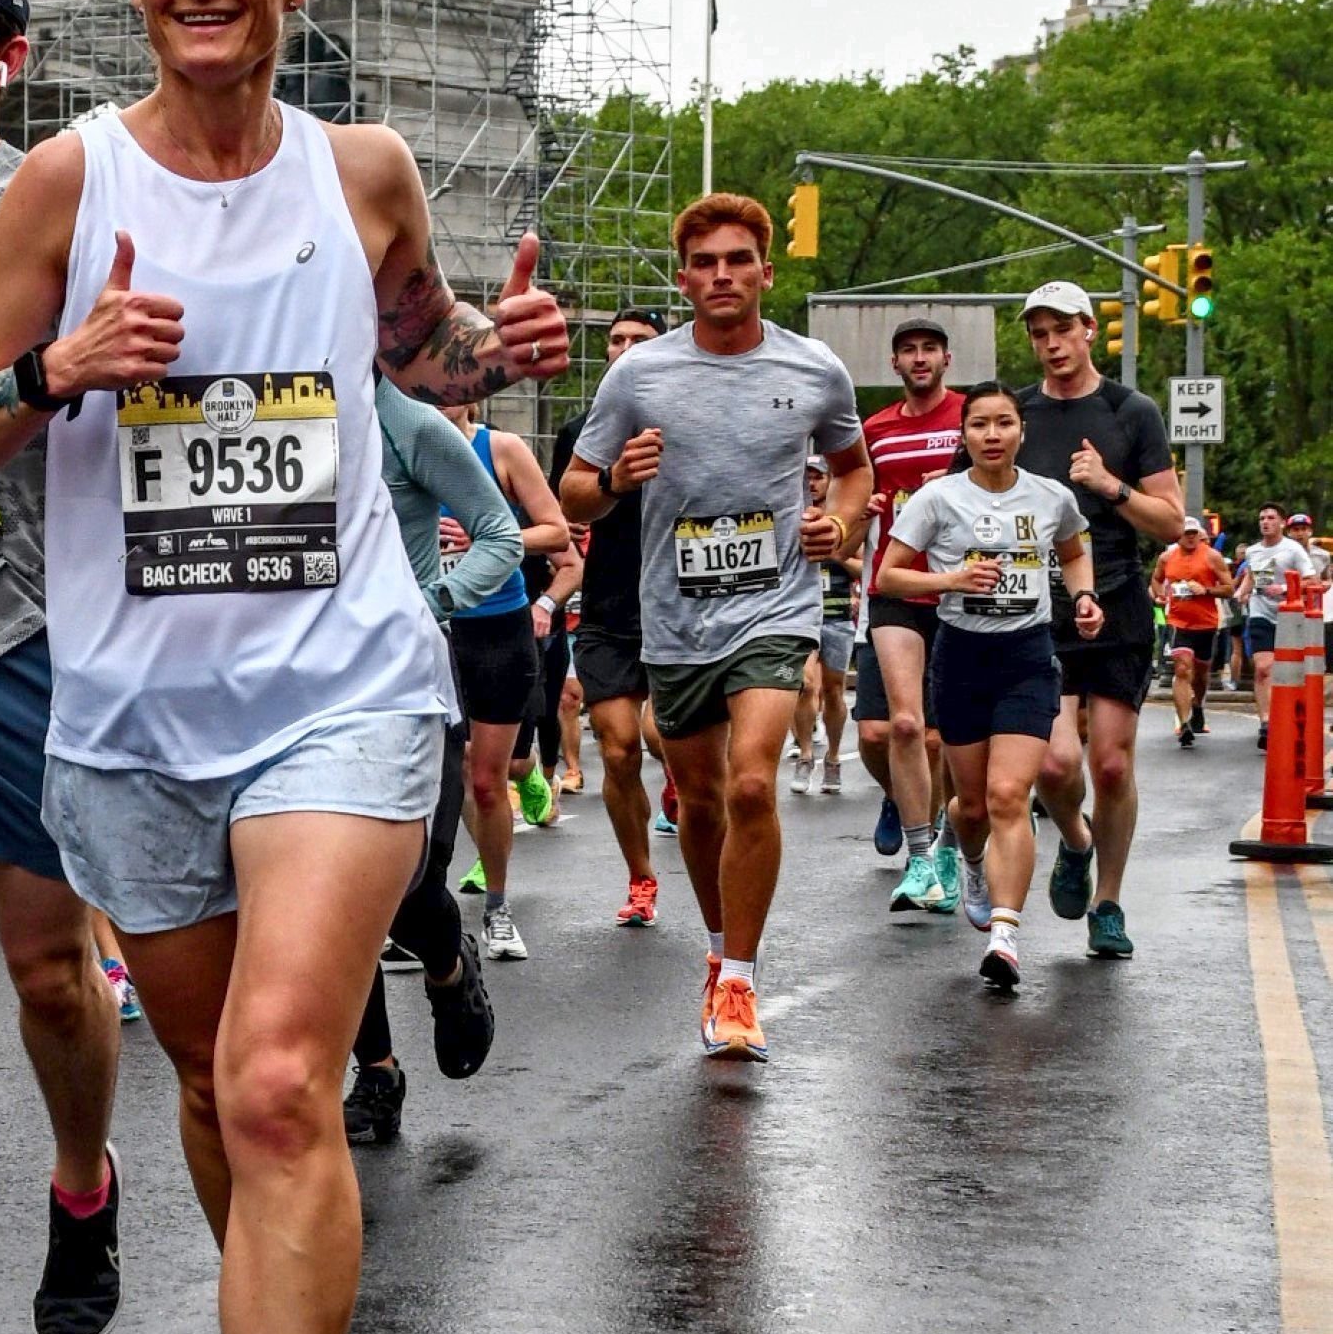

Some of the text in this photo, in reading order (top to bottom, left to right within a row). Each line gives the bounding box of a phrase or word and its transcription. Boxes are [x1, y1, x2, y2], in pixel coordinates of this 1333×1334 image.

[1177, 383, 1215, 395] KEEP
[204, 400, 254, 412] BROOKLYN
[217, 410, 241, 422] HALF
[1174, 424, 1218, 437] RIGHT
[134, 435, 303, 502] F 9536
[212, 507, 245, 523] WAVE
[680, 539, 762, 573] F 11627
[143, 556, 293, 588] BAG CHECK 9536
[992, 573, 1028, 595] 824
